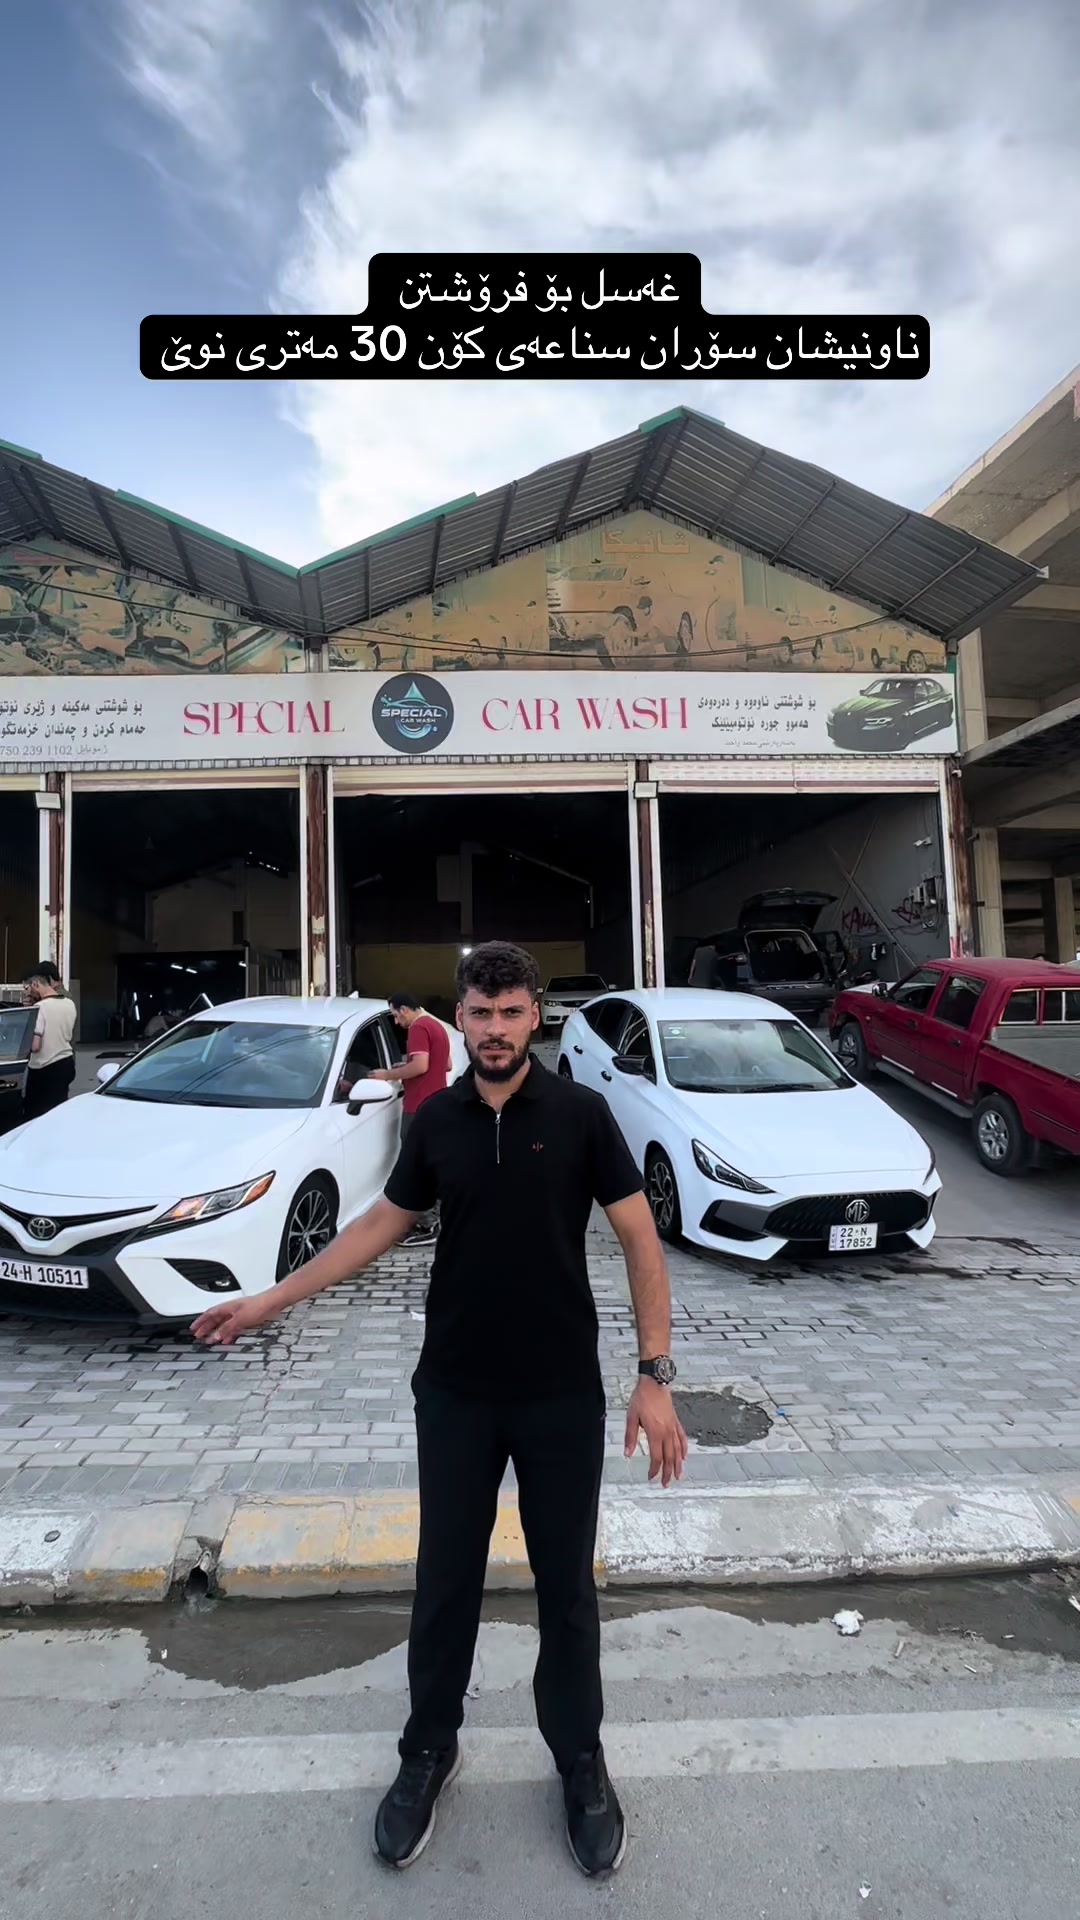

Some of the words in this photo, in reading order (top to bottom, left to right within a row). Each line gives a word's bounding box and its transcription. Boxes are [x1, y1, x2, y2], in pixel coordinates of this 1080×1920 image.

[50, 703, 56, 716] و
[735, 699, 740, 711] و
[183, 699, 346, 736] SPECIAL
[380, 708, 442, 718] SPECIAL
[481, 697, 561, 732] CAR
[576, 696, 689, 732] WASH
[81, 725, 88, 738] و
[22, 745, 43, 756] 239
[47, 745, 73, 756] 1102
[839, 1237, 873, 1249] 17852
[37, 1266, 84, 1286] 10511
